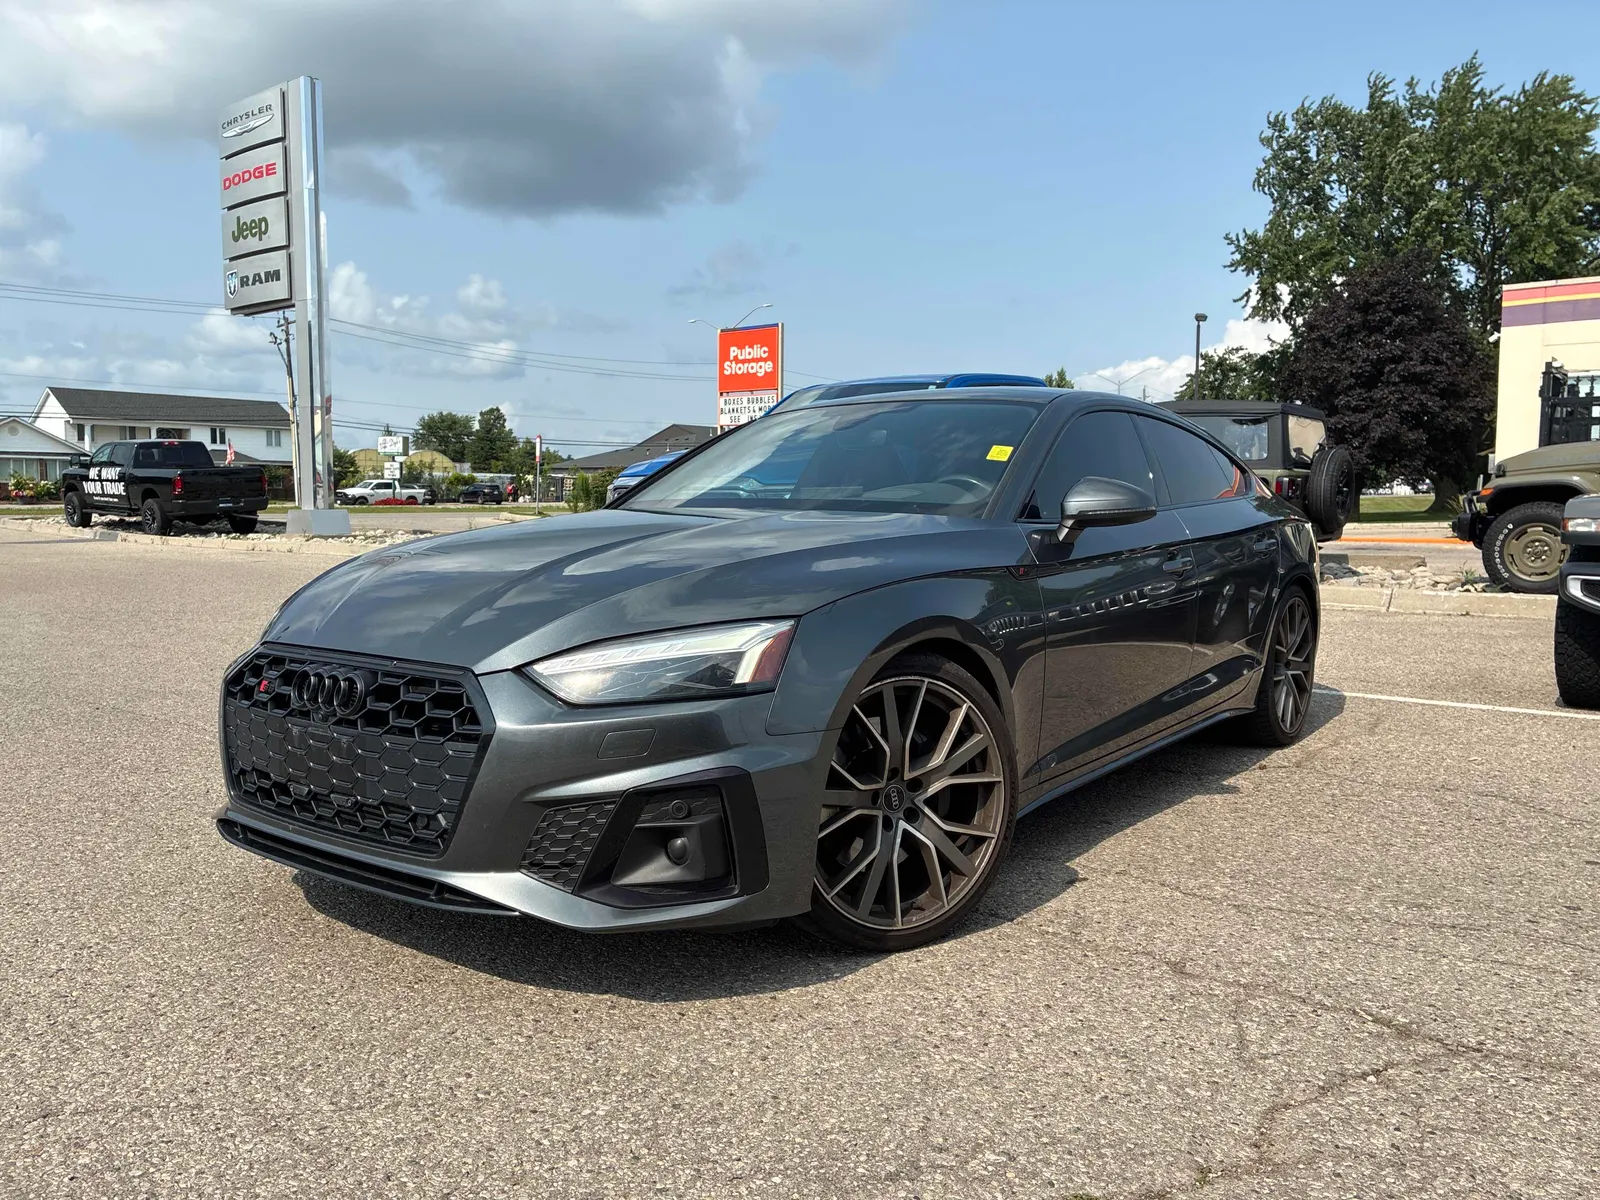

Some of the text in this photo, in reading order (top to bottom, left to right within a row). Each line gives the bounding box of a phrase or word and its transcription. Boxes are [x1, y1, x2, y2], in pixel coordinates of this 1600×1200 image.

[221, 104, 273, 129] CHRYSLER
[223, 162, 277, 190] DODGE
[232, 216, 269, 242] Jeep
[240, 269, 281, 288] RAM
[730, 344, 768, 360] Public
[724, 361, 773, 377] Storage
[724, 396, 775, 406] BOXES BUBBLES
[720, 406, 751, 415] BLANKETS
[730, 415, 740, 423] SEE
[89, 467, 121, 480] WE WANT
[82, 481, 126, 495] YOUR TRADE
